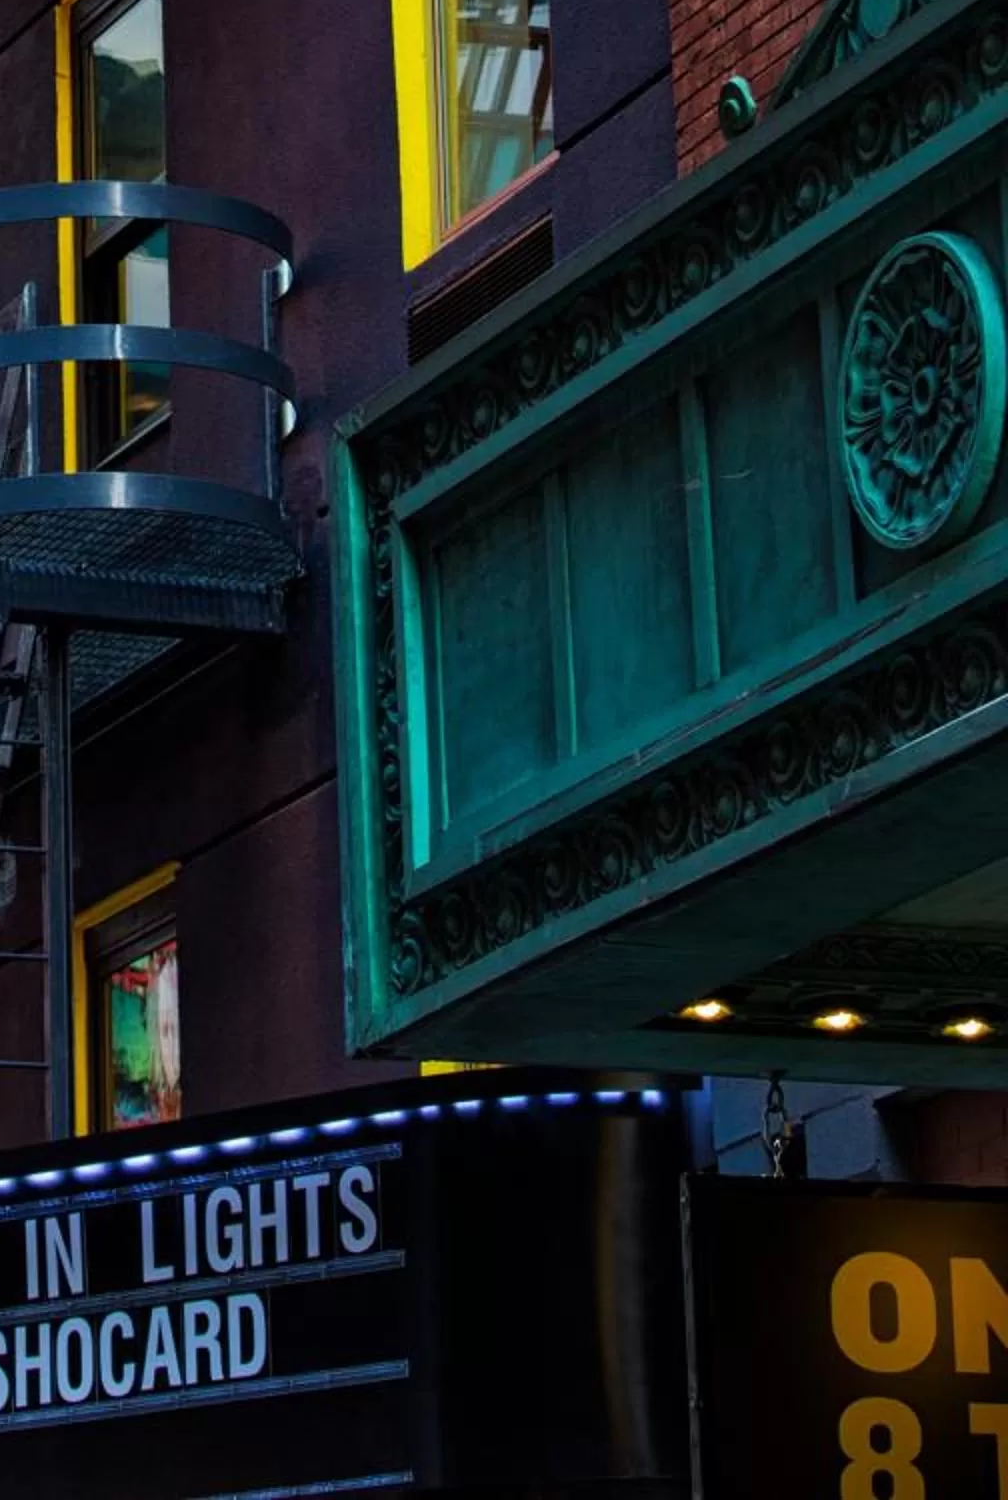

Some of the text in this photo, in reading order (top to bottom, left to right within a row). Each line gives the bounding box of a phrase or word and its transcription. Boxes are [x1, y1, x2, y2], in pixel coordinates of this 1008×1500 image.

[25, 1212, 85, 1300] IN
[140, 1165, 378, 1284] LIGHTS
[839, 1397, 926, 1500] 8
